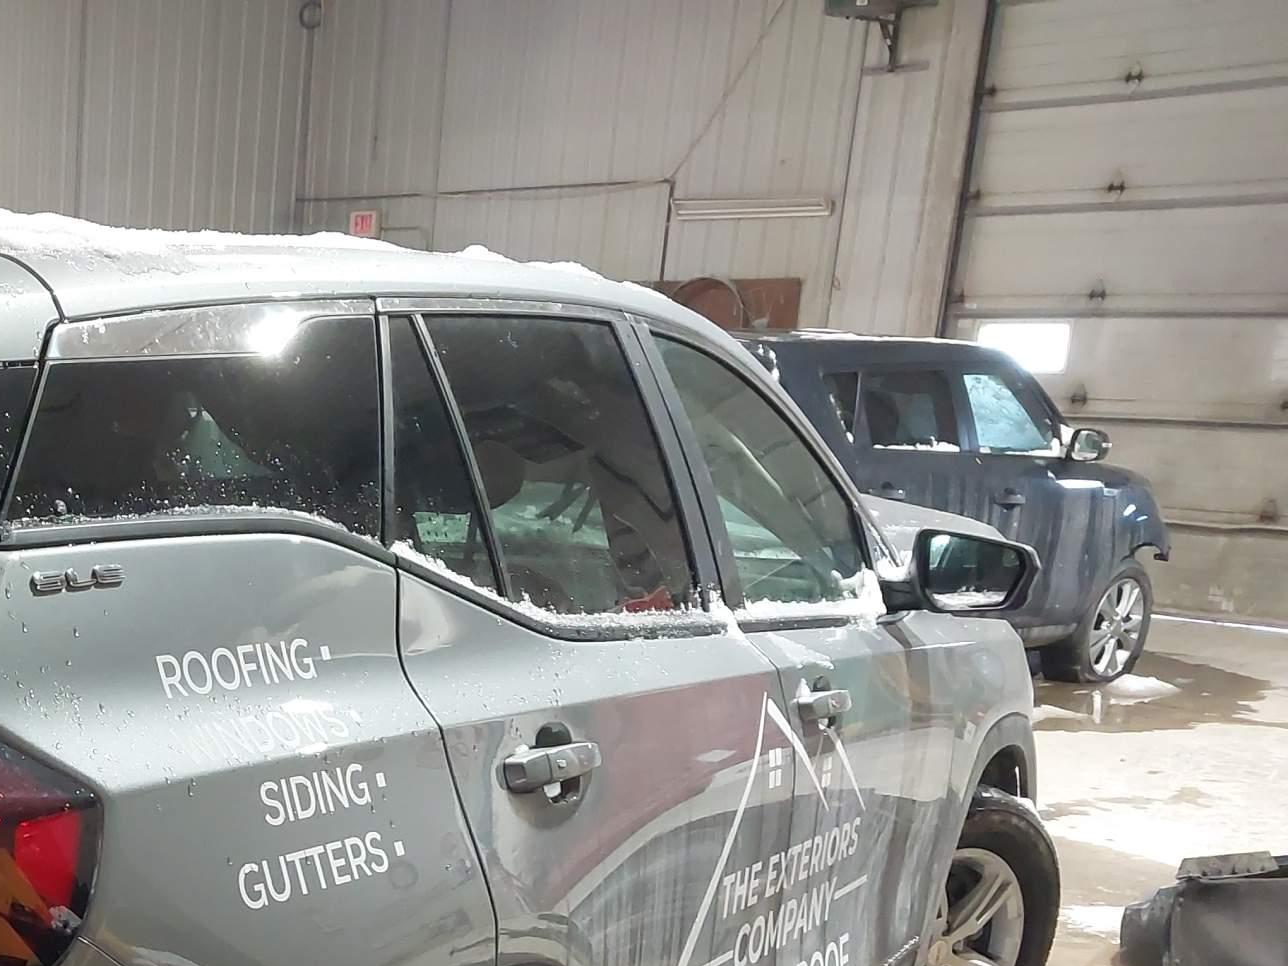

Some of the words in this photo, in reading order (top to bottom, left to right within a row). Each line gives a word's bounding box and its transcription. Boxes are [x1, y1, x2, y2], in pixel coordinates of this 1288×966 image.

[31, 563, 126, 597] SLE
[155, 637, 318, 699] ROOFING
[259, 762, 372, 826] SIDING
[238, 831, 389, 909] GUTTERS
[722, 861, 763, 920] THE
[764, 817, 861, 898] EXTERIORS
